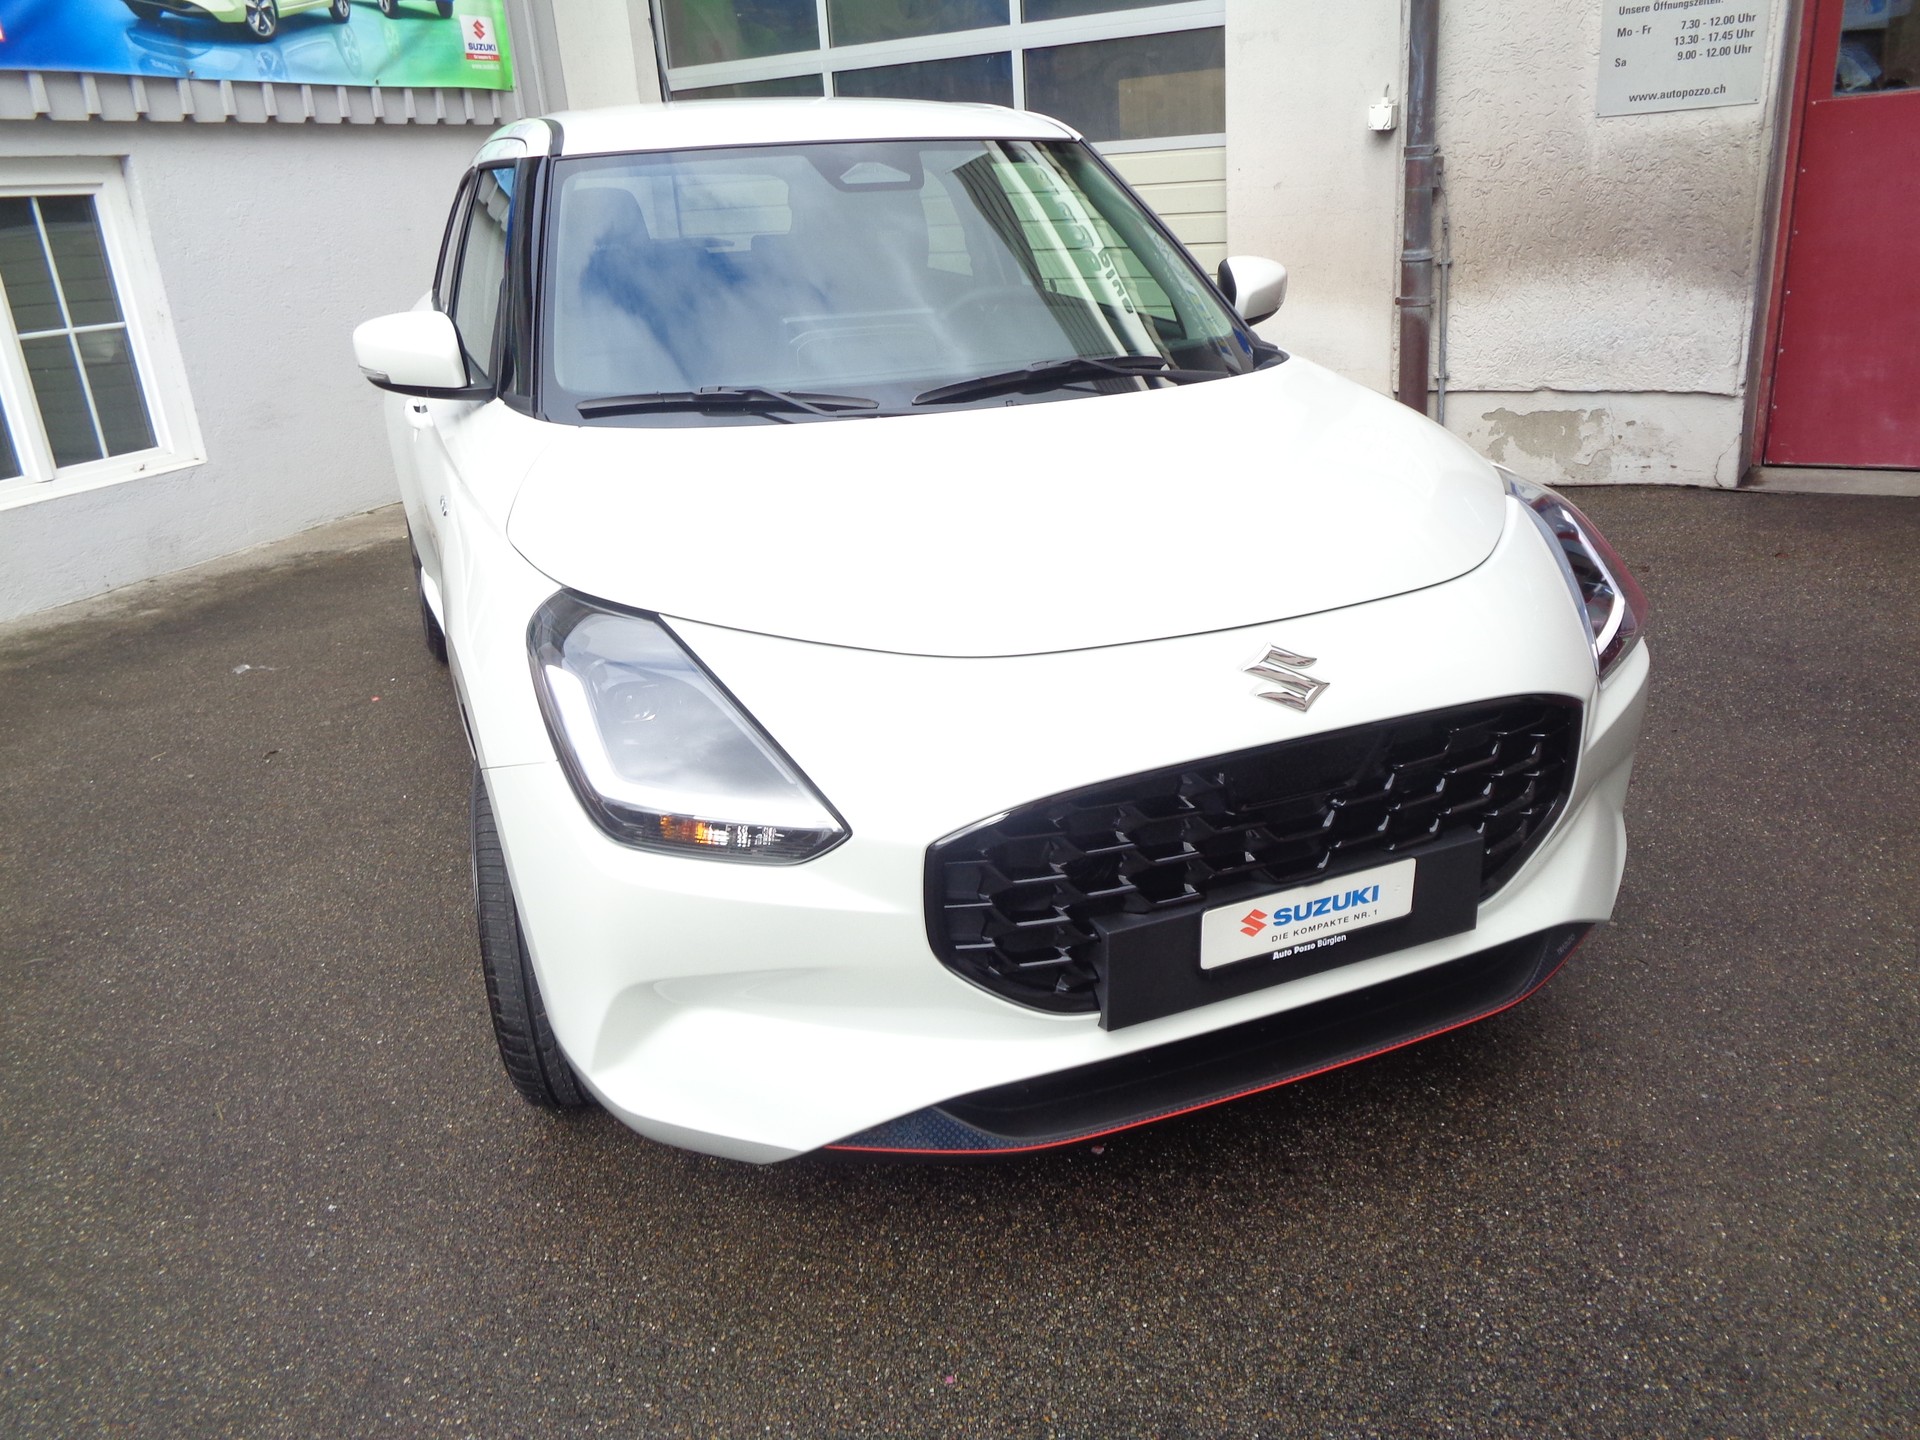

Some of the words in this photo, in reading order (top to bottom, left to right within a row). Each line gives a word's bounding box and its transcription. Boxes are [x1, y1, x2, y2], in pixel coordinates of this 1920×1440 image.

[1618, 5, 1650, 16] Unsere
[1616, 27, 1633, 38] Mo
[1642, 25, 1652, 35] Fr
[1681, 18, 1700, 30] 7.30
[1710, 15, 1735, 26] 12.00
[1738, 12, 1756, 23] Uhr
[1675, 34, 1699, 46] 13.30
[1709, 30, 1733, 42] 17.45
[1736, 28, 1755, 39] Uhr
[468, 42, 496, 51] SUZUKI
[1614, 57, 1627, 68] Sa
[1677, 49, 1697, 60] 9.00
[1707, 46, 1731, 57] 12.00
[1734, 44, 1752, 55] Uhr
[1628, 83, 1726, 102] www.autopozzo.ch
[1273, 884, 1380, 927] SUZUKI
[1271, 932, 1289, 942] DIE
[1293, 915, 1350, 937] KOMPAKTE
[1353, 911, 1370, 921] NR.
[1272, 949, 1293, 960] Auto
[1317, 934, 1347, 948] Bürglen
